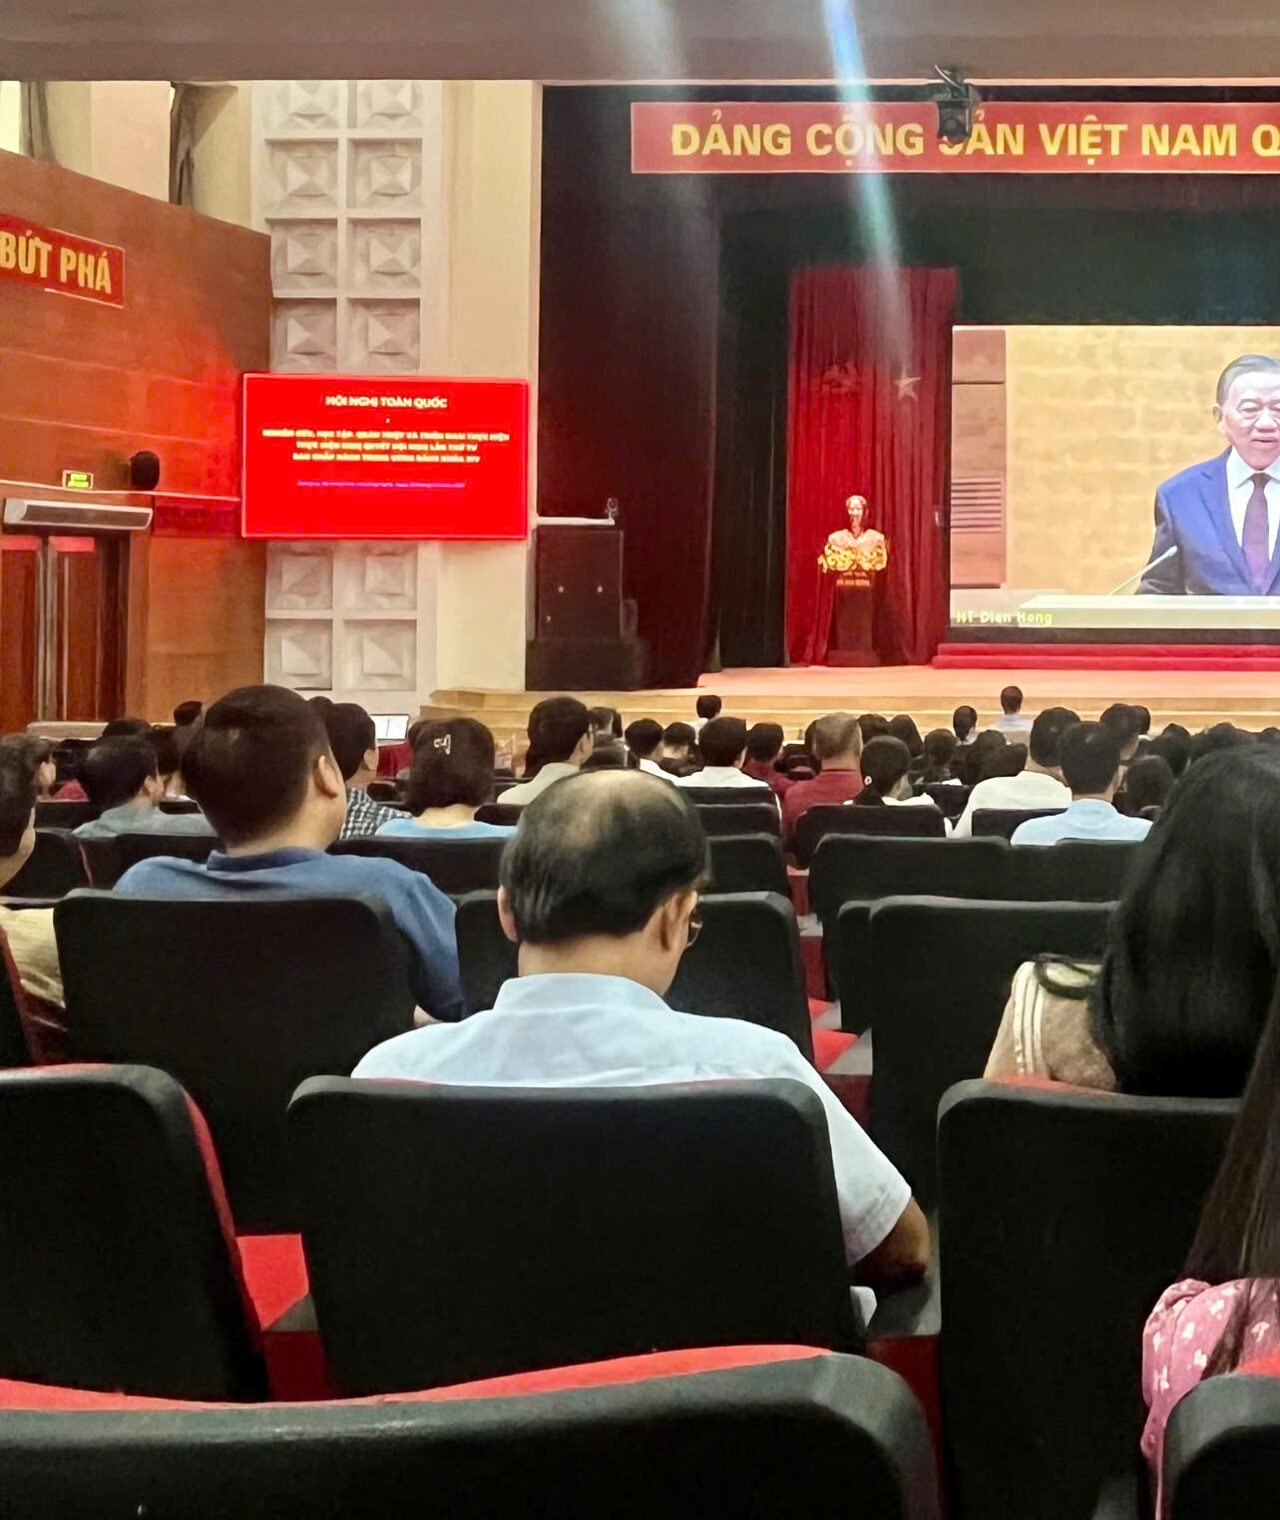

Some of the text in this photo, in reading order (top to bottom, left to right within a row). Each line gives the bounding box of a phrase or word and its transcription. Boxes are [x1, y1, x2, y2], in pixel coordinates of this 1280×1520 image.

[671, 108, 792, 156] ĐẢNG
[806, 113, 924, 168] CỘNG
[1038, 115, 1128, 165] VIỆT
[1141, 123, 1237, 156] NAM
[60, 246, 112, 295] PHÁ
[326, 395, 348, 407] HỘI
[380, 396, 412, 408] TOÀN
[413, 396, 448, 409] QUỐC
